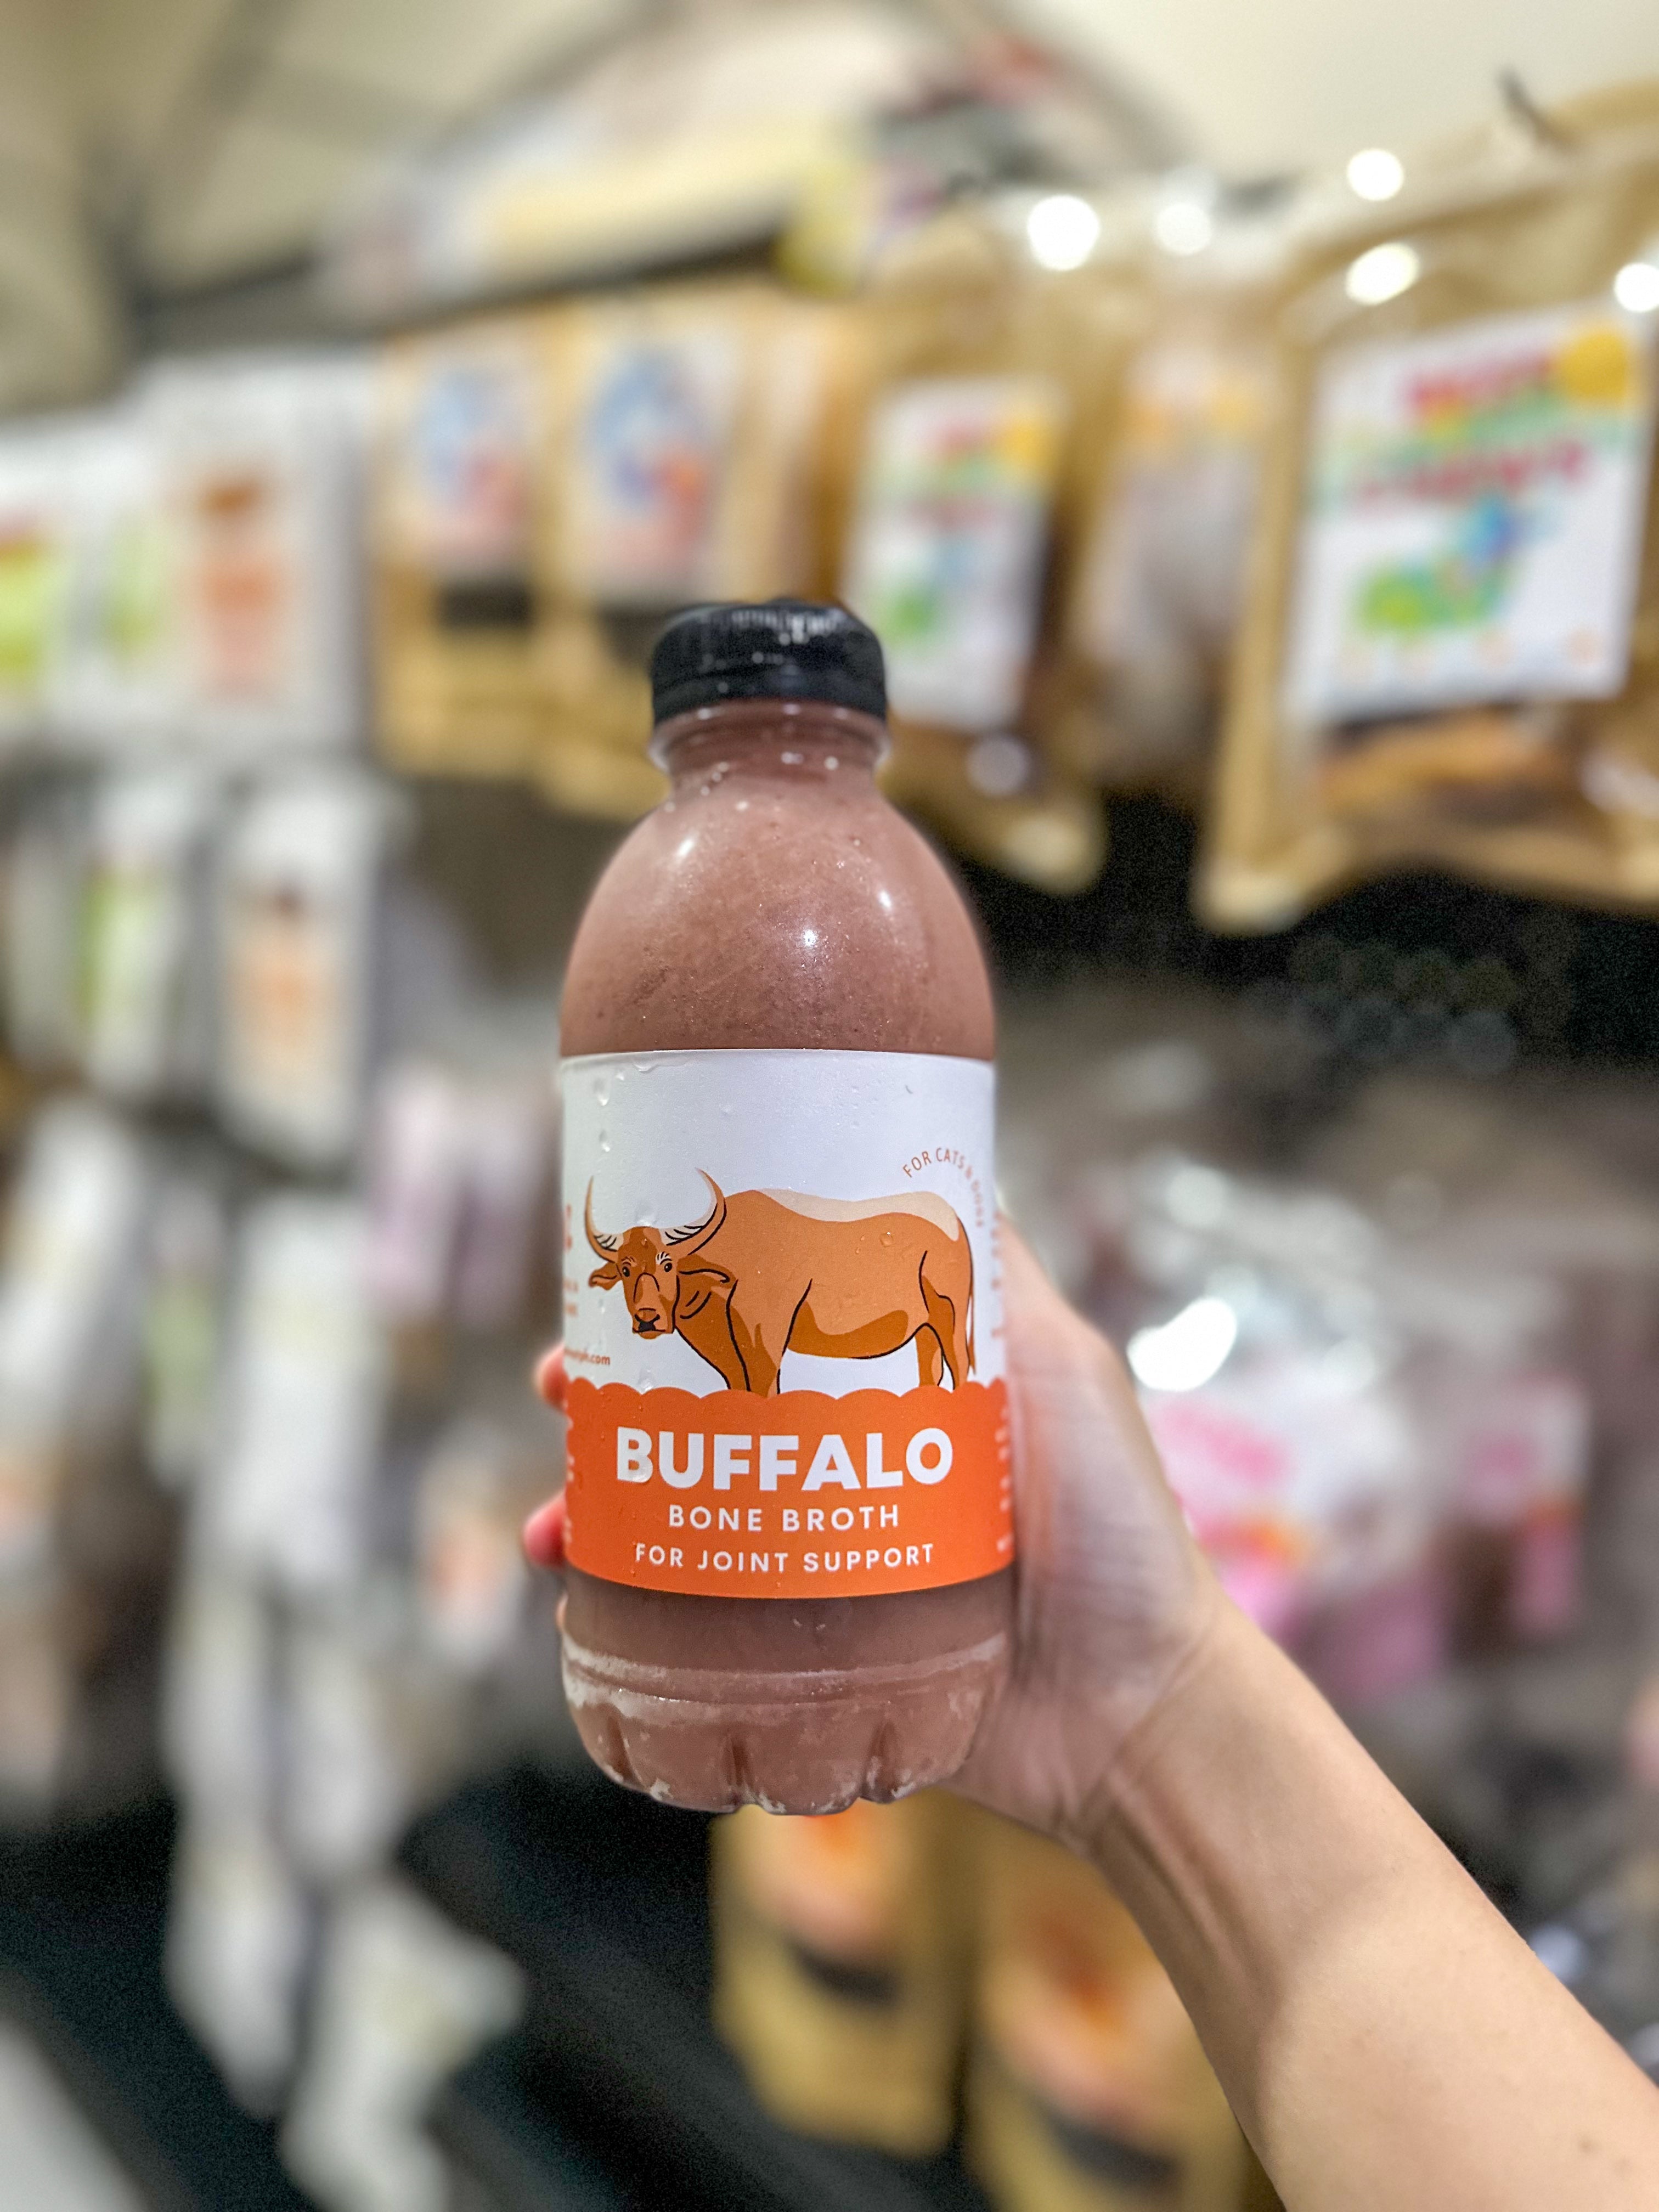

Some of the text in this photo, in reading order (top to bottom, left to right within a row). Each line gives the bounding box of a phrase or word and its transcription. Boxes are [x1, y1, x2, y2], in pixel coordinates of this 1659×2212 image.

[902, 1147, 965, 1178] FOR CATS
[617, 1426, 953, 1492] BUFFALO
[669, 1504, 899, 1532] BONE BROTH
[635, 1543, 934, 1573] FOR JOINT SUPPORT
